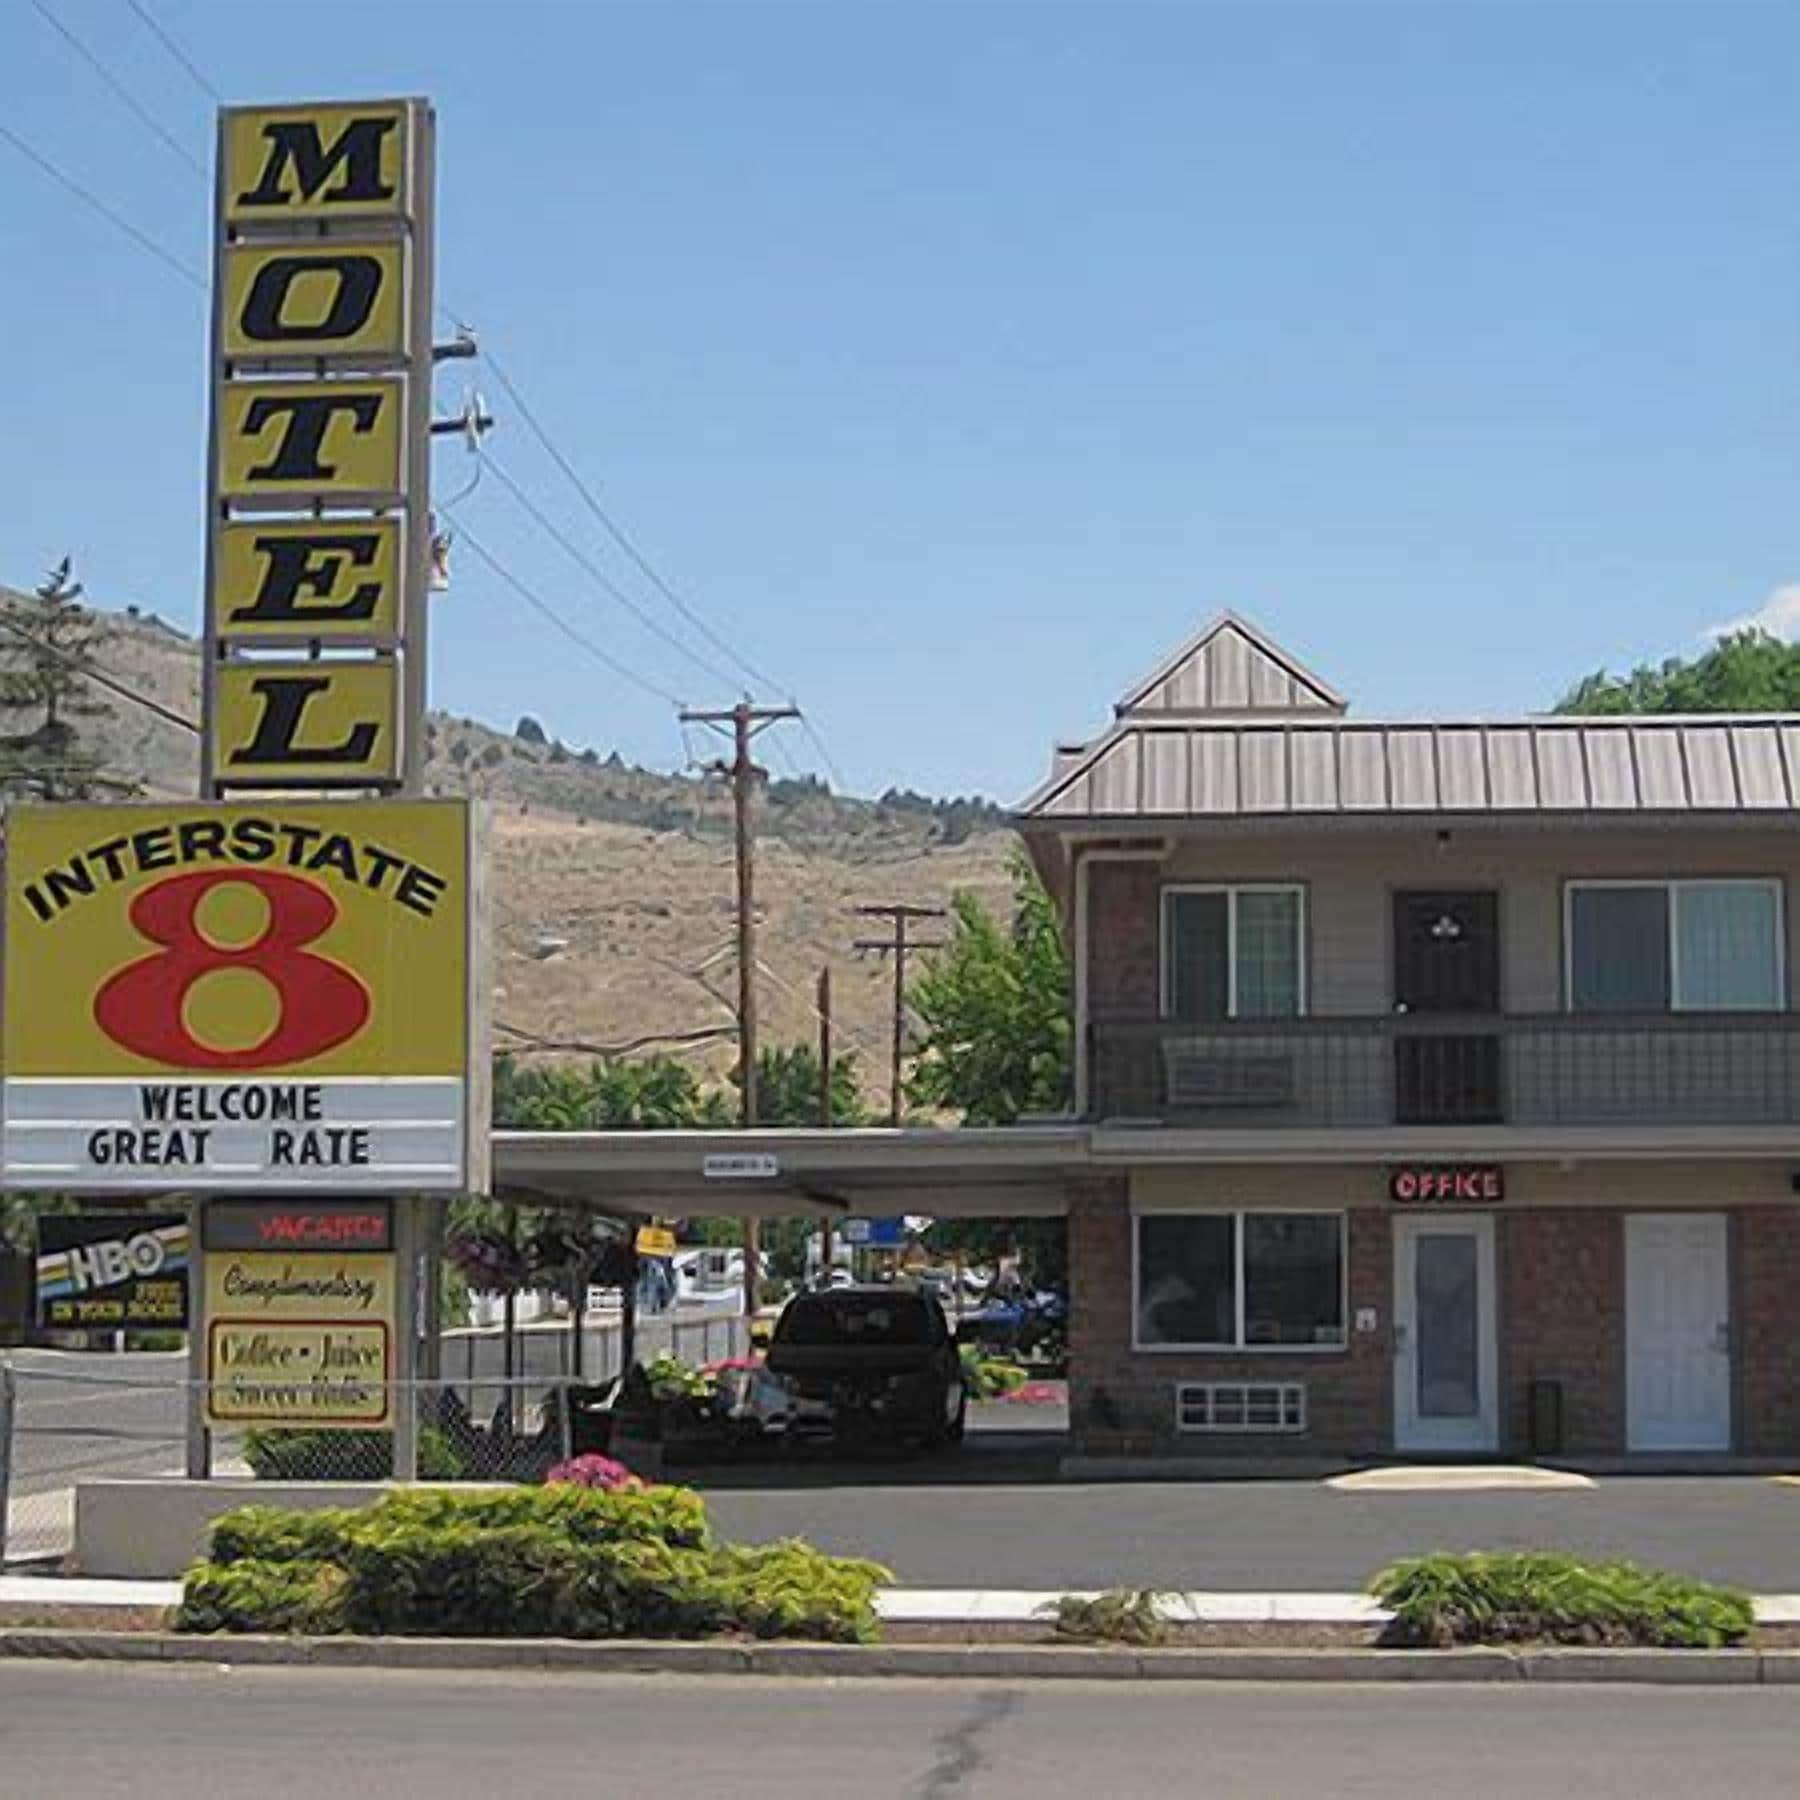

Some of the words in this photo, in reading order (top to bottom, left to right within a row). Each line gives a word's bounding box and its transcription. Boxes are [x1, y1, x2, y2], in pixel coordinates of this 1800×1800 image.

[231, 116, 397, 766] MOTEL
[24, 819, 446, 922] INTERSTATE
[94, 868, 371, 1069] 8
[140, 1085, 323, 1120] WELCOME
[88, 1128, 211, 1165] GREAT
[270, 1128, 370, 1165] RATE
[1396, 1171, 1500, 1197] OFFICE
[69, 1233, 165, 1291] HBO
[223, 1262, 377, 1309] Complimentary
